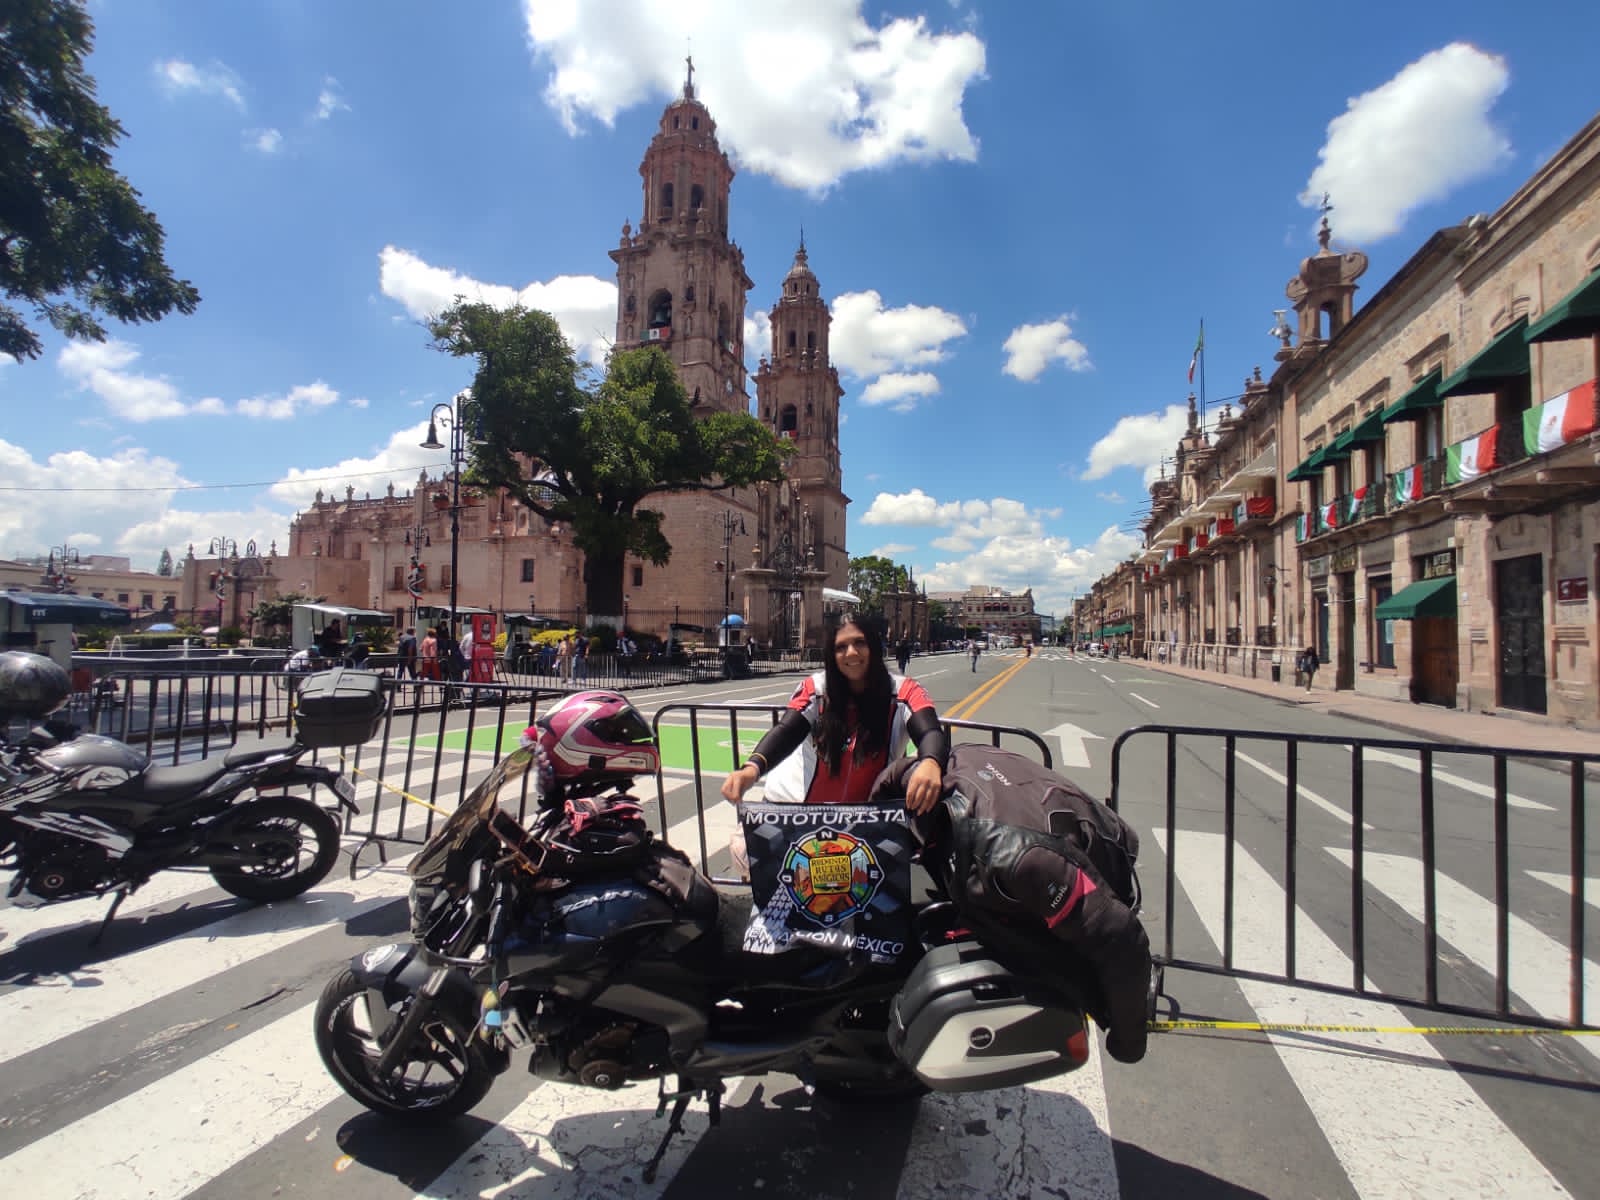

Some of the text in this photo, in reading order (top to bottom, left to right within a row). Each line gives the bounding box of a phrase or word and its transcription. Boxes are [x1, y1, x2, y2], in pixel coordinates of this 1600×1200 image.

[745, 808, 906, 825] MOTOTURISTA
[821, 831, 833, 839] N
[870, 870, 880, 878] E
[842, 934, 904, 955] MÉXICO
